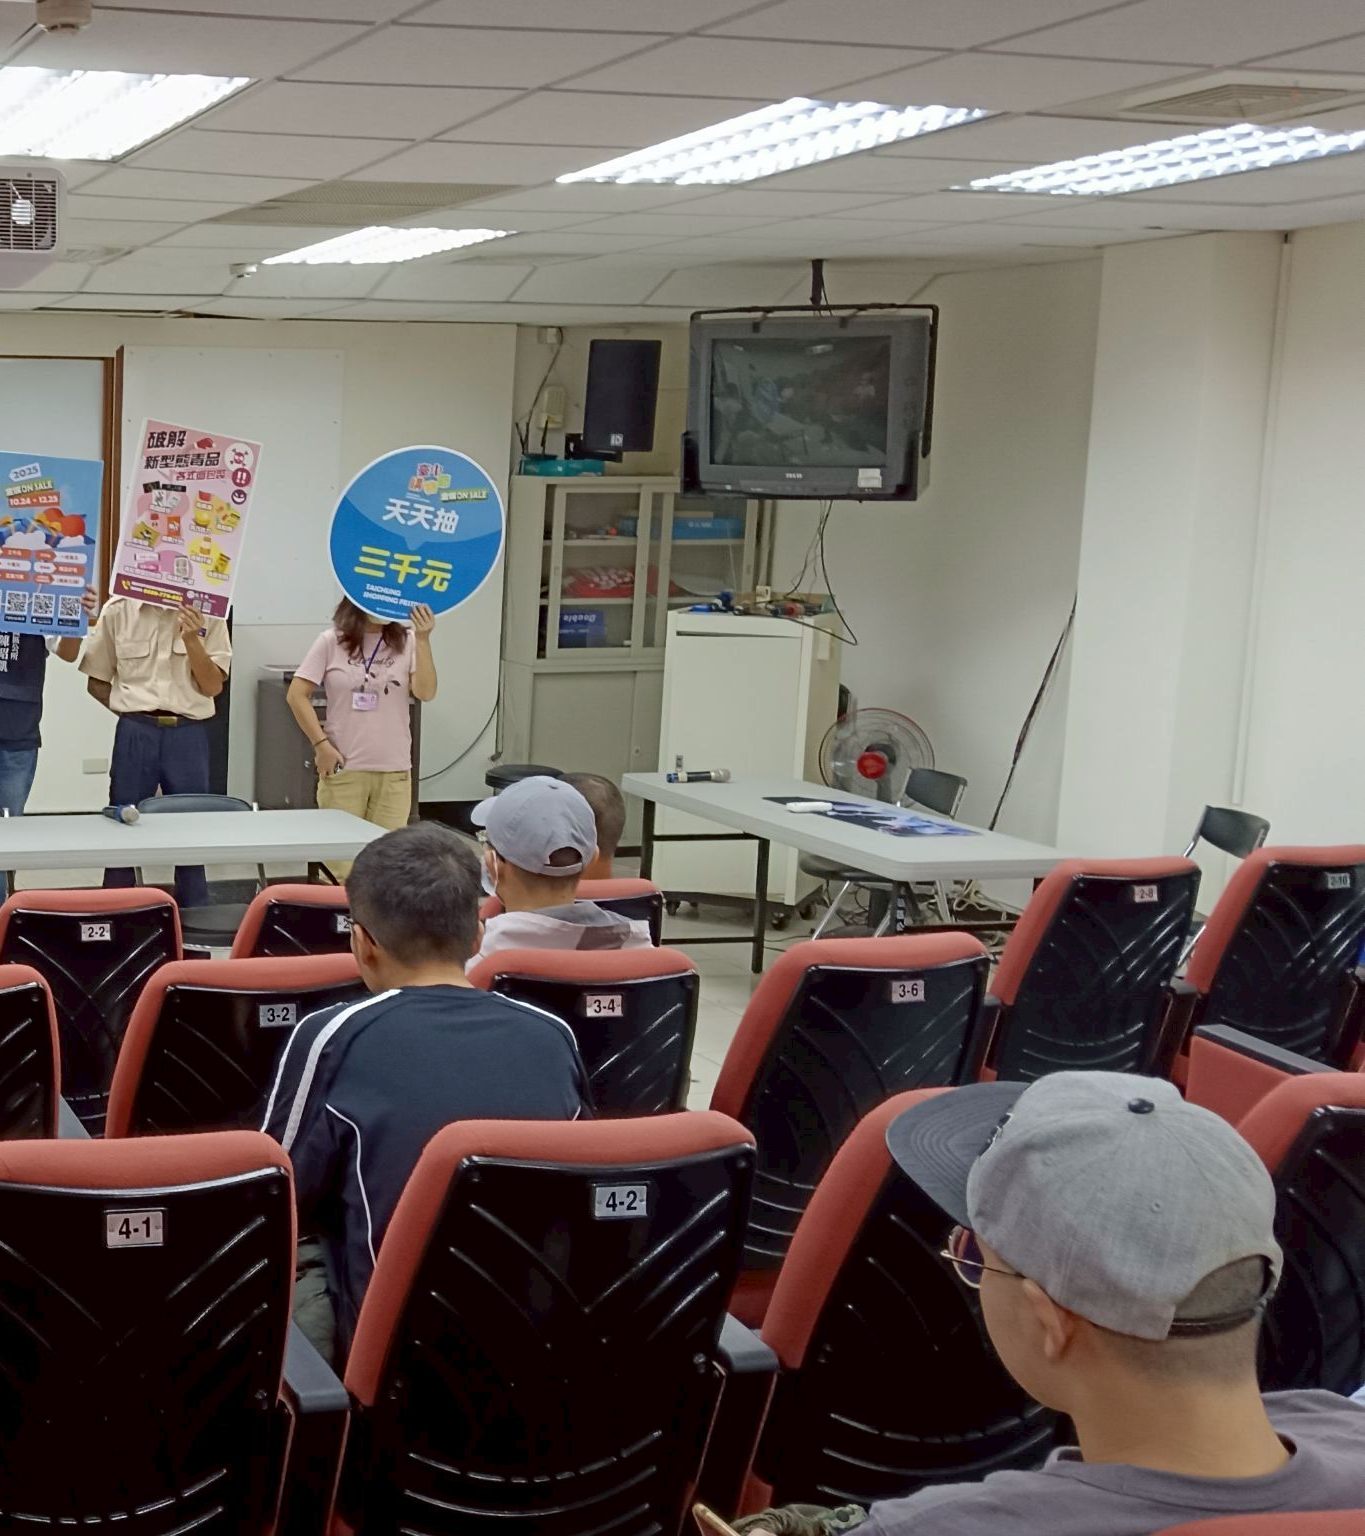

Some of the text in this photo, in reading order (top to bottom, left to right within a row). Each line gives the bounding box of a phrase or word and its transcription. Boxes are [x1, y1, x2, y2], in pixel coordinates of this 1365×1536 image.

[147, 430, 187, 449] 破解
[12, 466, 40, 480] 2025
[382, 498, 460, 535] 天天抽
[354, 545, 453, 592] 三千元
[88, 926, 106, 938] 2-2
[898, 983, 918, 998] 3-6
[267, 1006, 290, 1022] 3-2
[593, 998, 616, 1014] 3-4
[605, 1190, 638, 1212] 4-2
[118, 1216, 151, 1240] 4-1
